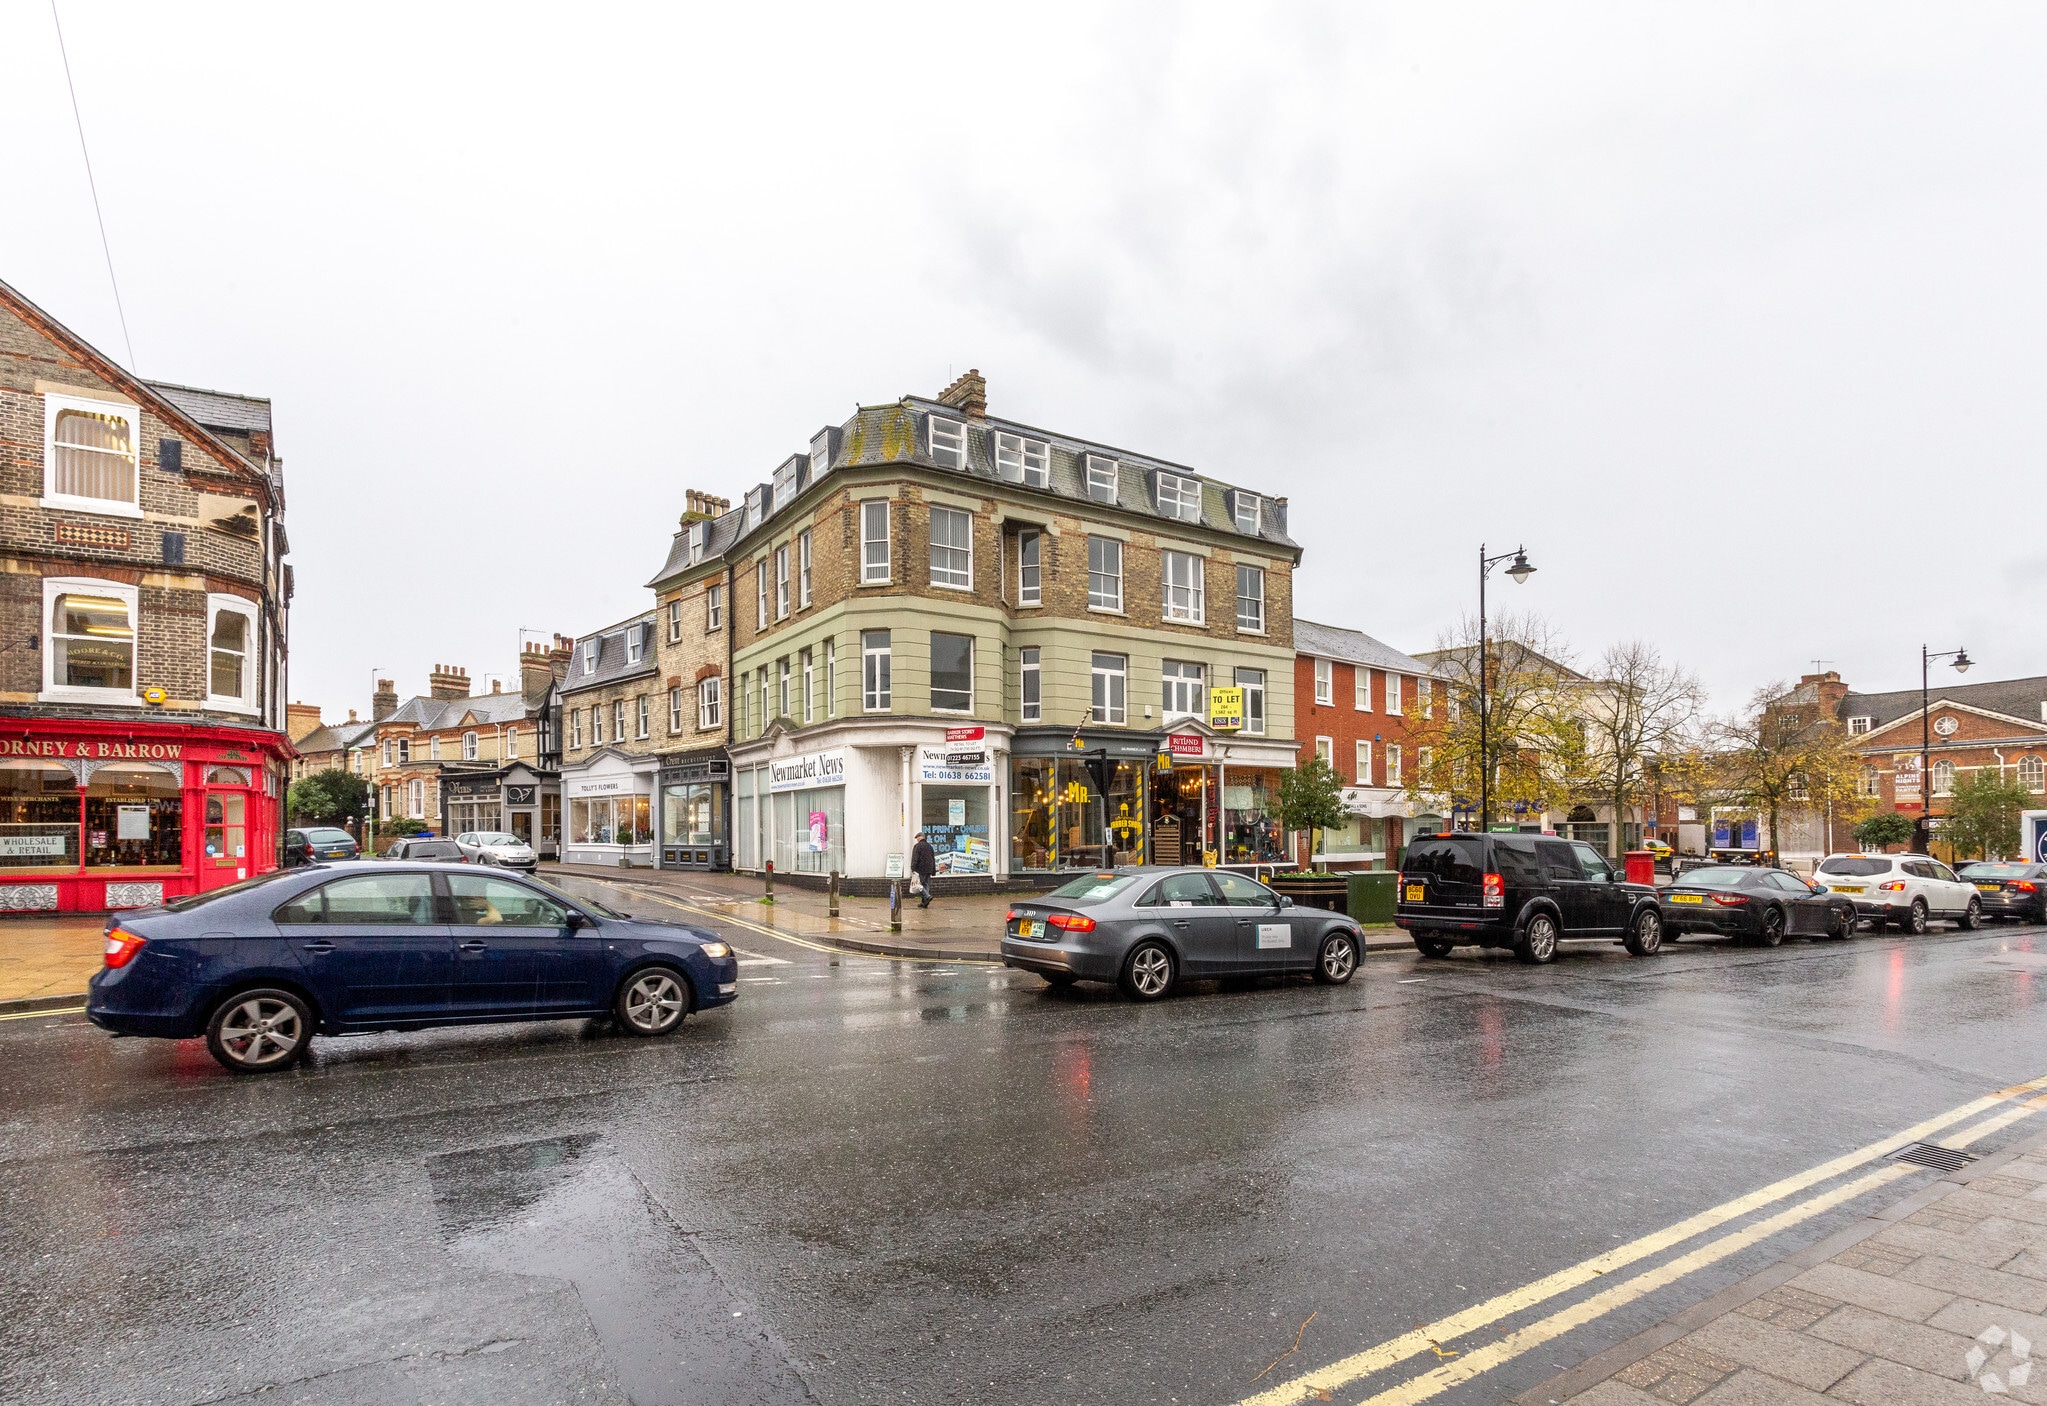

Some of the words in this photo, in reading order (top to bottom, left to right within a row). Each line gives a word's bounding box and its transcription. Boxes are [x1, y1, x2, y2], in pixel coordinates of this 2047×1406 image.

[1213, 695, 1223, 704] TO
[1226, 695, 1240, 703] LET
[1173, 737, 1199, 746] RUTLAND
[76, 741, 90, 757] &
[97, 743, 183, 759] BARROW
[1170, 744, 1202, 753] CHAMBERS
[771, 757, 816, 783] Newmarket
[819, 754, 844, 776] News
[923, 770, 937, 779] Tel:
[938, 771, 962, 780] 01638
[964, 772, 991, 781] 662581
[581, 784, 598, 792] TOLLY'S
[598, 783, 619, 791] FLOWERS
[922, 825, 931, 834] IN
[932, 825, 955, 834] PRINT
[959, 825, 988, 834] ONLINE
[3, 836, 58, 846] WHOLESALE
[926, 834, 933, 843] &
[933, 834, 947, 843] ON
[6, 847, 15, 855] &
[18, 845, 52, 855] RETAIL
[939, 843, 953, 853] GO
